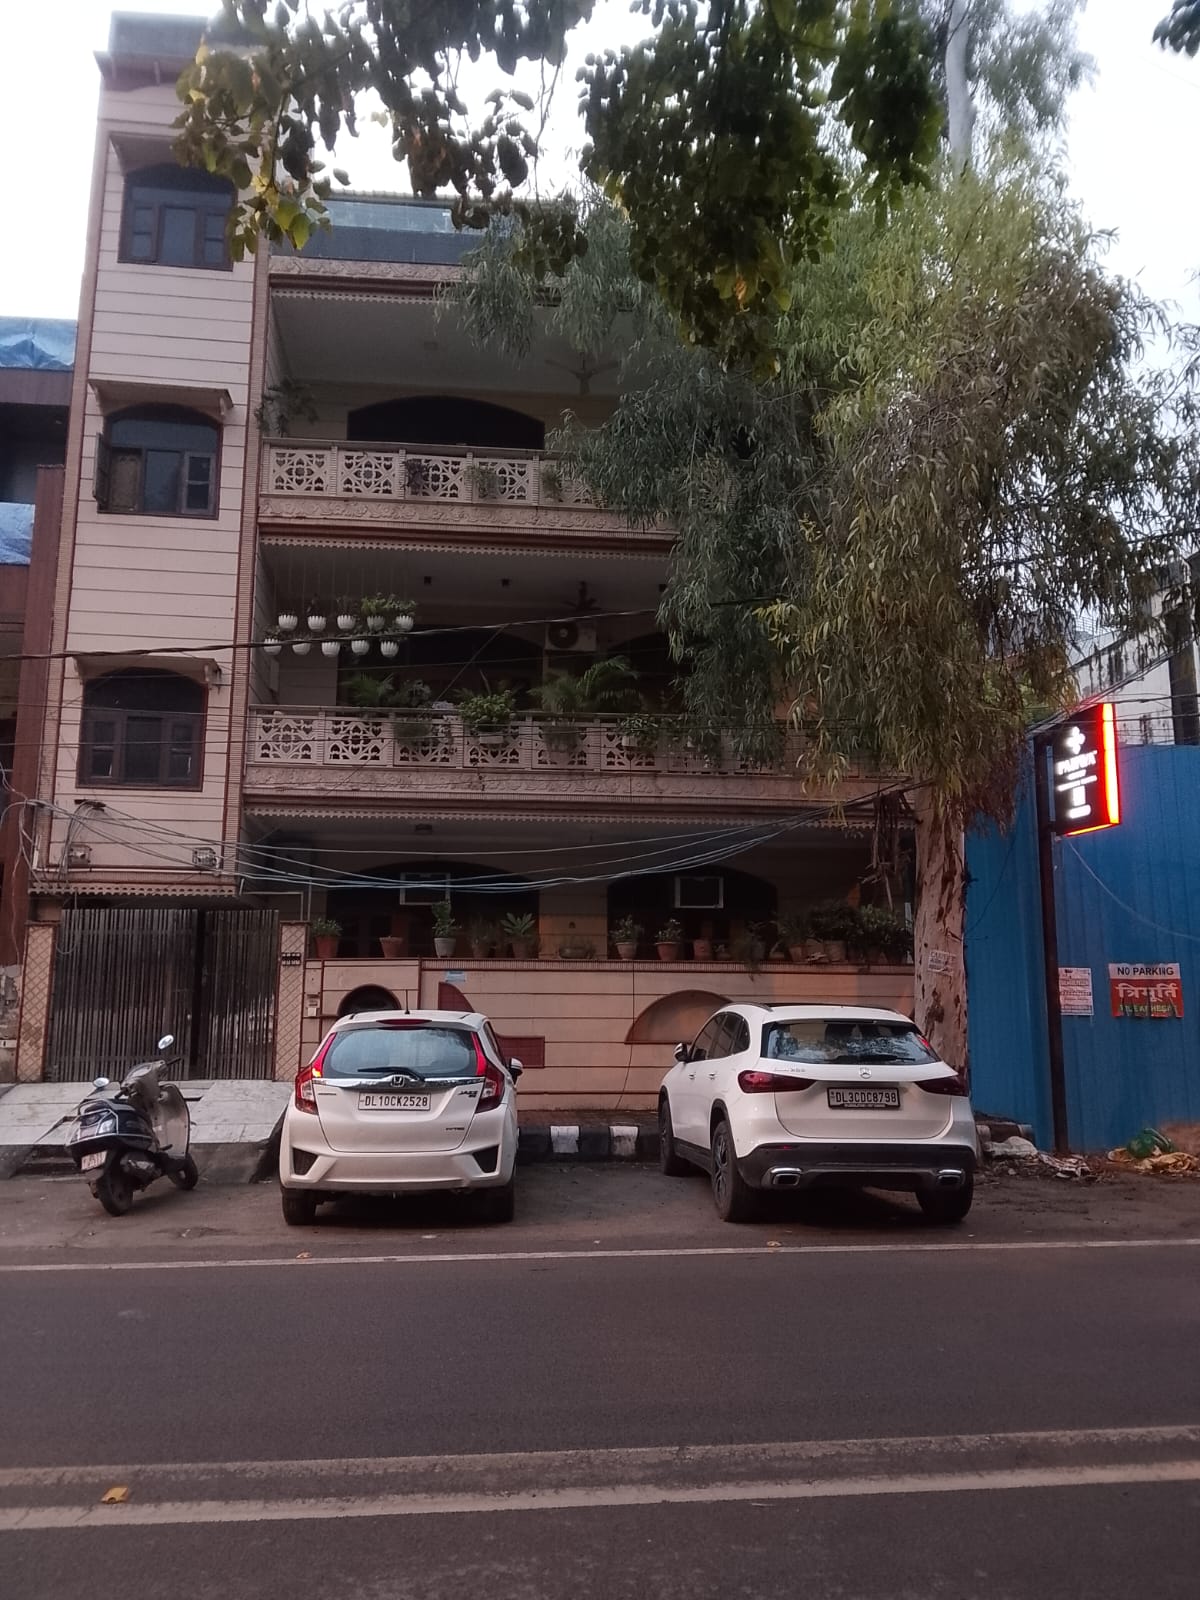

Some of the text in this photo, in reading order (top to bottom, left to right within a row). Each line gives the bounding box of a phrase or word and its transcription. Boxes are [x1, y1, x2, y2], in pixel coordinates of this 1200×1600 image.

[1117, 966, 1175, 976] NO PARKING
[364, 1095, 428, 1108] DL10CK2528
